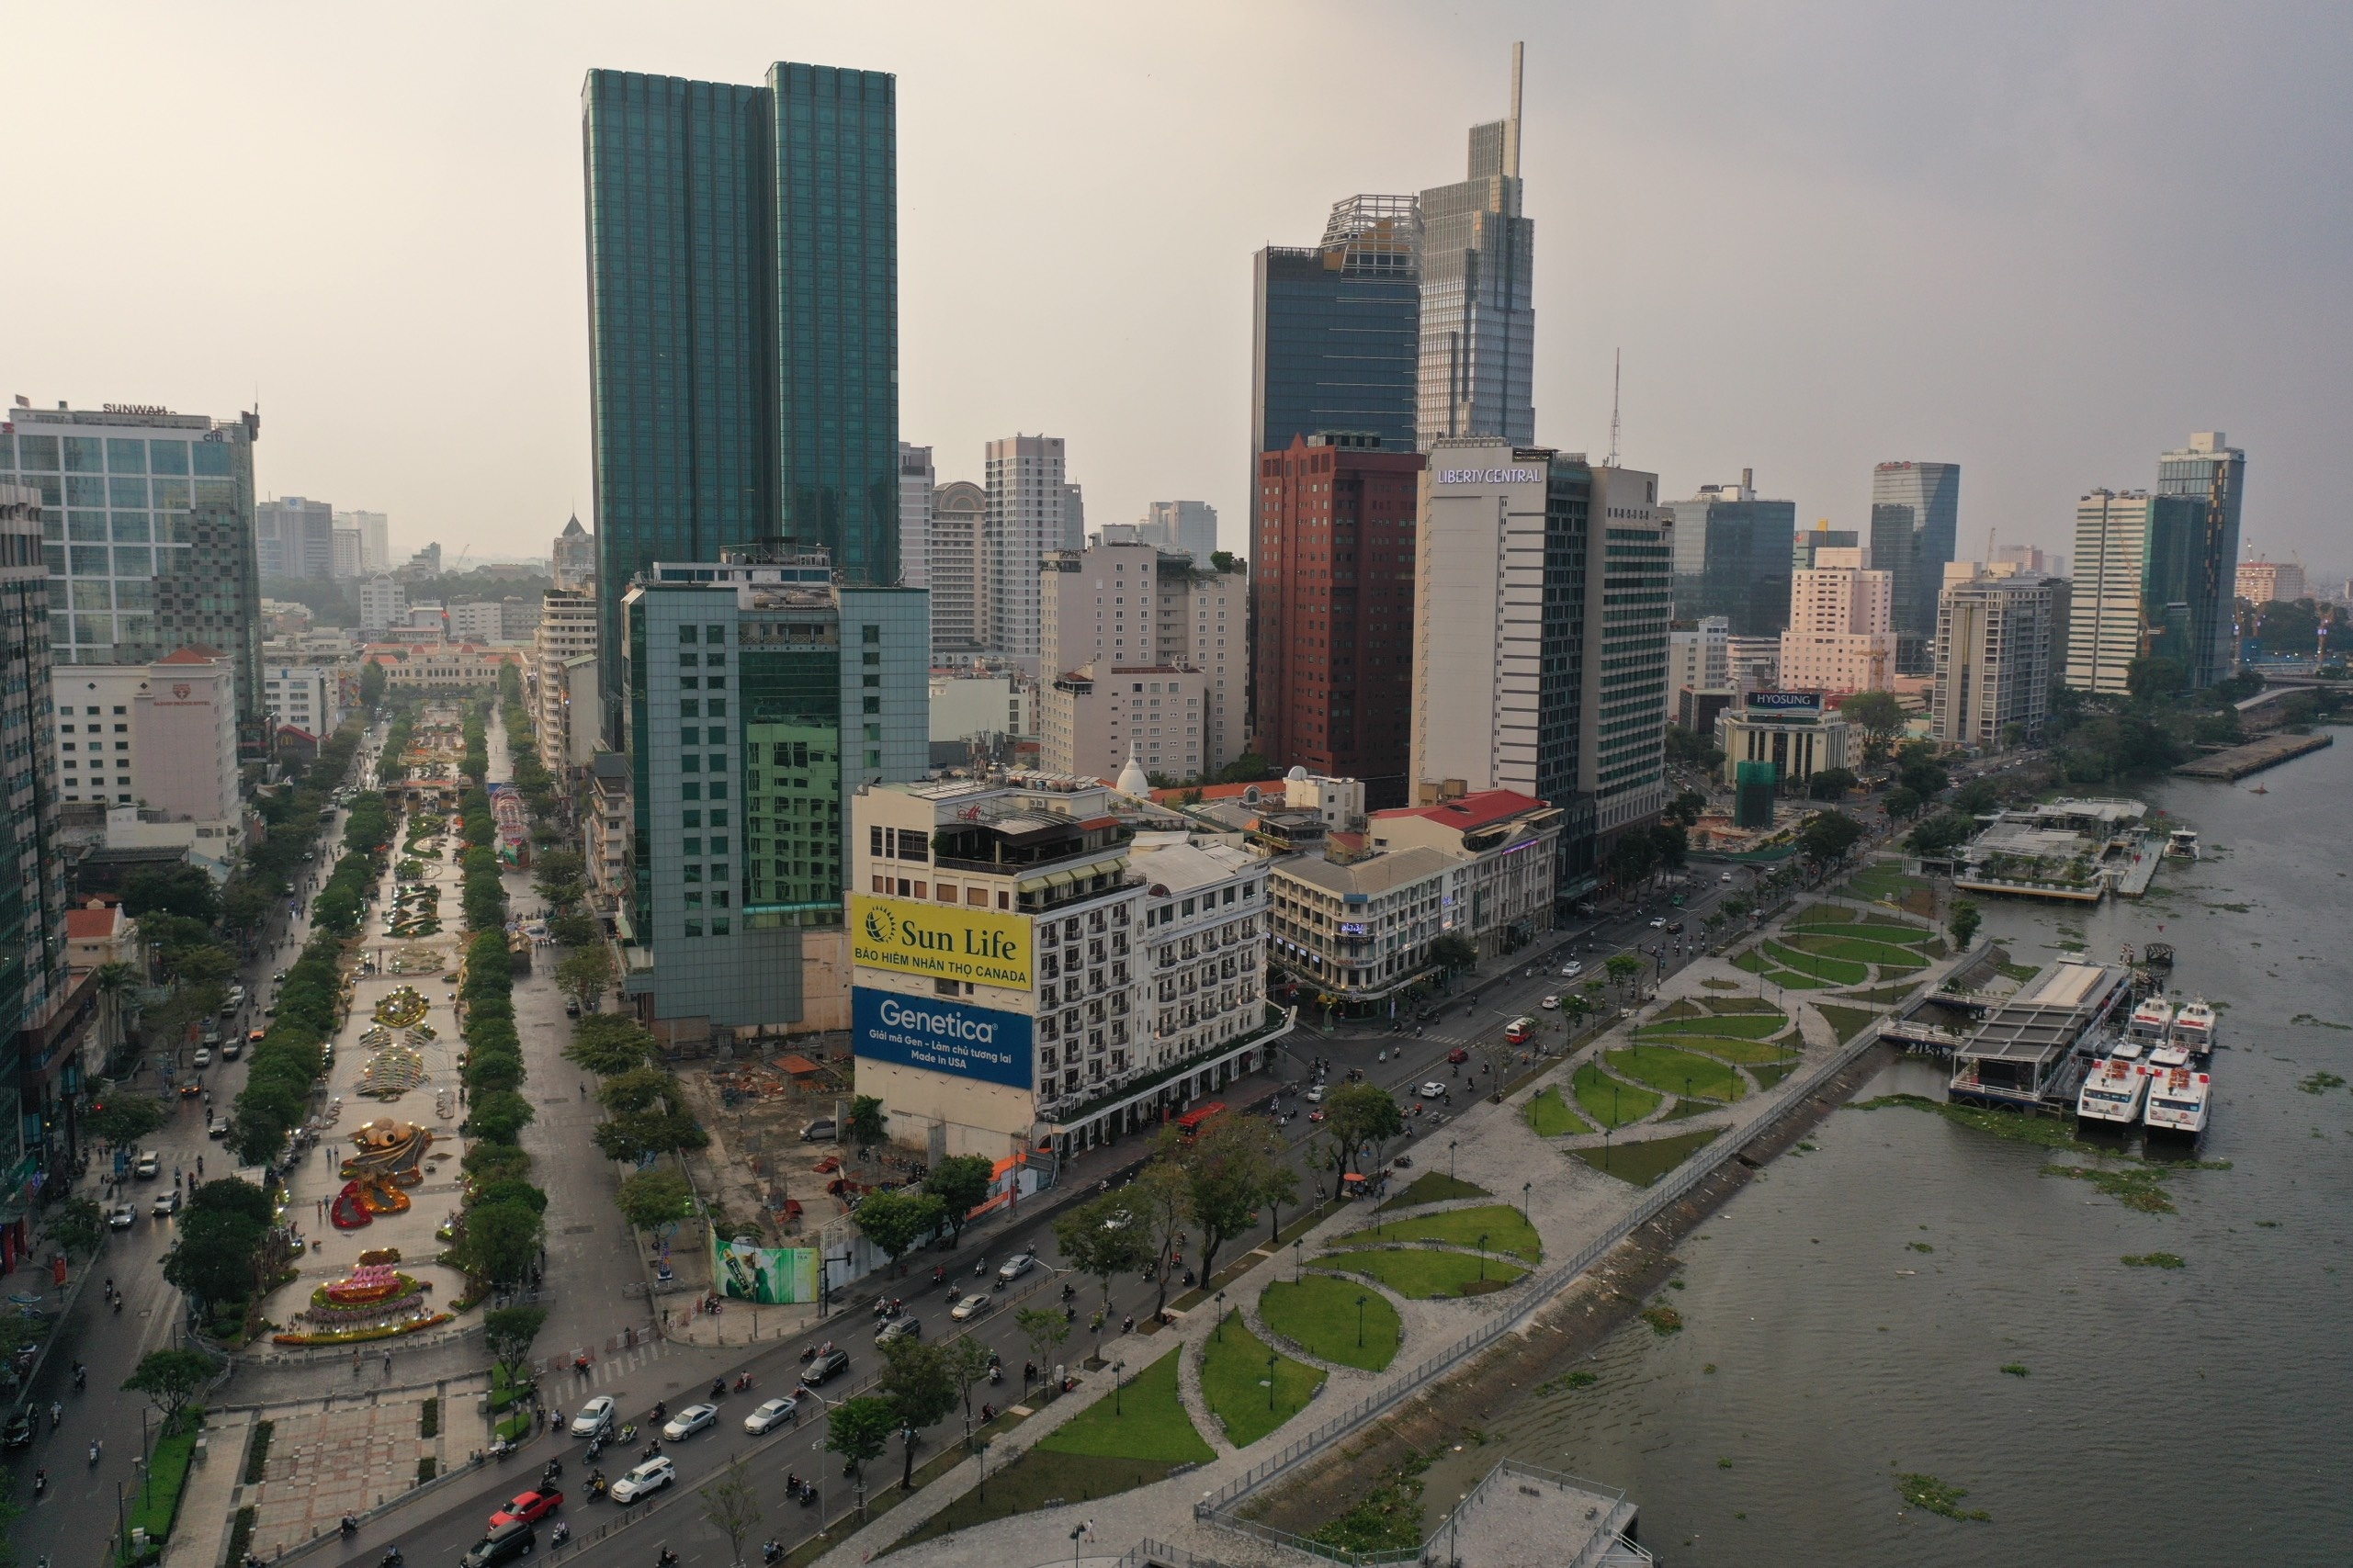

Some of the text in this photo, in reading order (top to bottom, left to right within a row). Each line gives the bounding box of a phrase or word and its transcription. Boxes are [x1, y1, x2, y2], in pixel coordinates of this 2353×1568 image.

[103, 403, 166, 415] SUNWAH
[203, 430, 223, 443] citi
[1438, 468, 1542, 483] LIBERTY CENTRAL
[1646, 480, 1654, 503] R
[1757, 694, 1810, 705] HYOSUNG
[901, 920, 1017, 960] Sun Life
[854, 947, 878, 961] BẢO
[912, 956, 945, 971] NHÂN
[948, 962, 972, 977] THỌ
[976, 966, 1026, 983] CANADA
[904, 1035, 922, 1047] Gen
[932, 1040, 950, 1053] Làm
[911, 1050, 967, 1069] Made in USA
[353, 1263, 394, 1282] 2022
